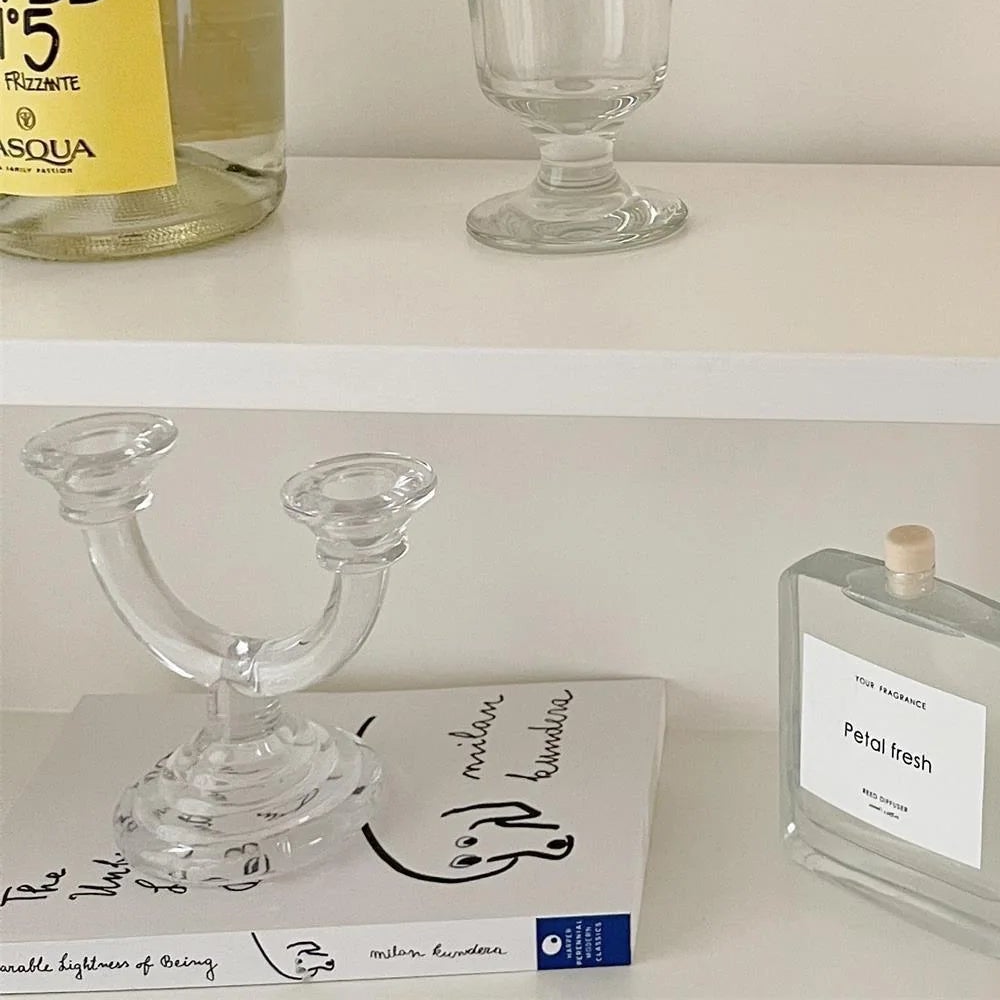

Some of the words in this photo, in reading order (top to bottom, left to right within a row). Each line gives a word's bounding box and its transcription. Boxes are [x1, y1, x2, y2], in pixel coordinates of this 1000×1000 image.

[4, 71, 81, 91] FRIZZANTE
[855, 675, 875, 689] YOUR
[879, 685, 927, 710] FRAGRANCE
[843, 721, 886, 755] Petal
[890, 742, 933, 774] fresh
[594, 921, 603, 962] CLASSICS
[58, 953, 130, 980] Lightness
[135, 955, 154, 976] of
[160, 954, 219, 982] Being
